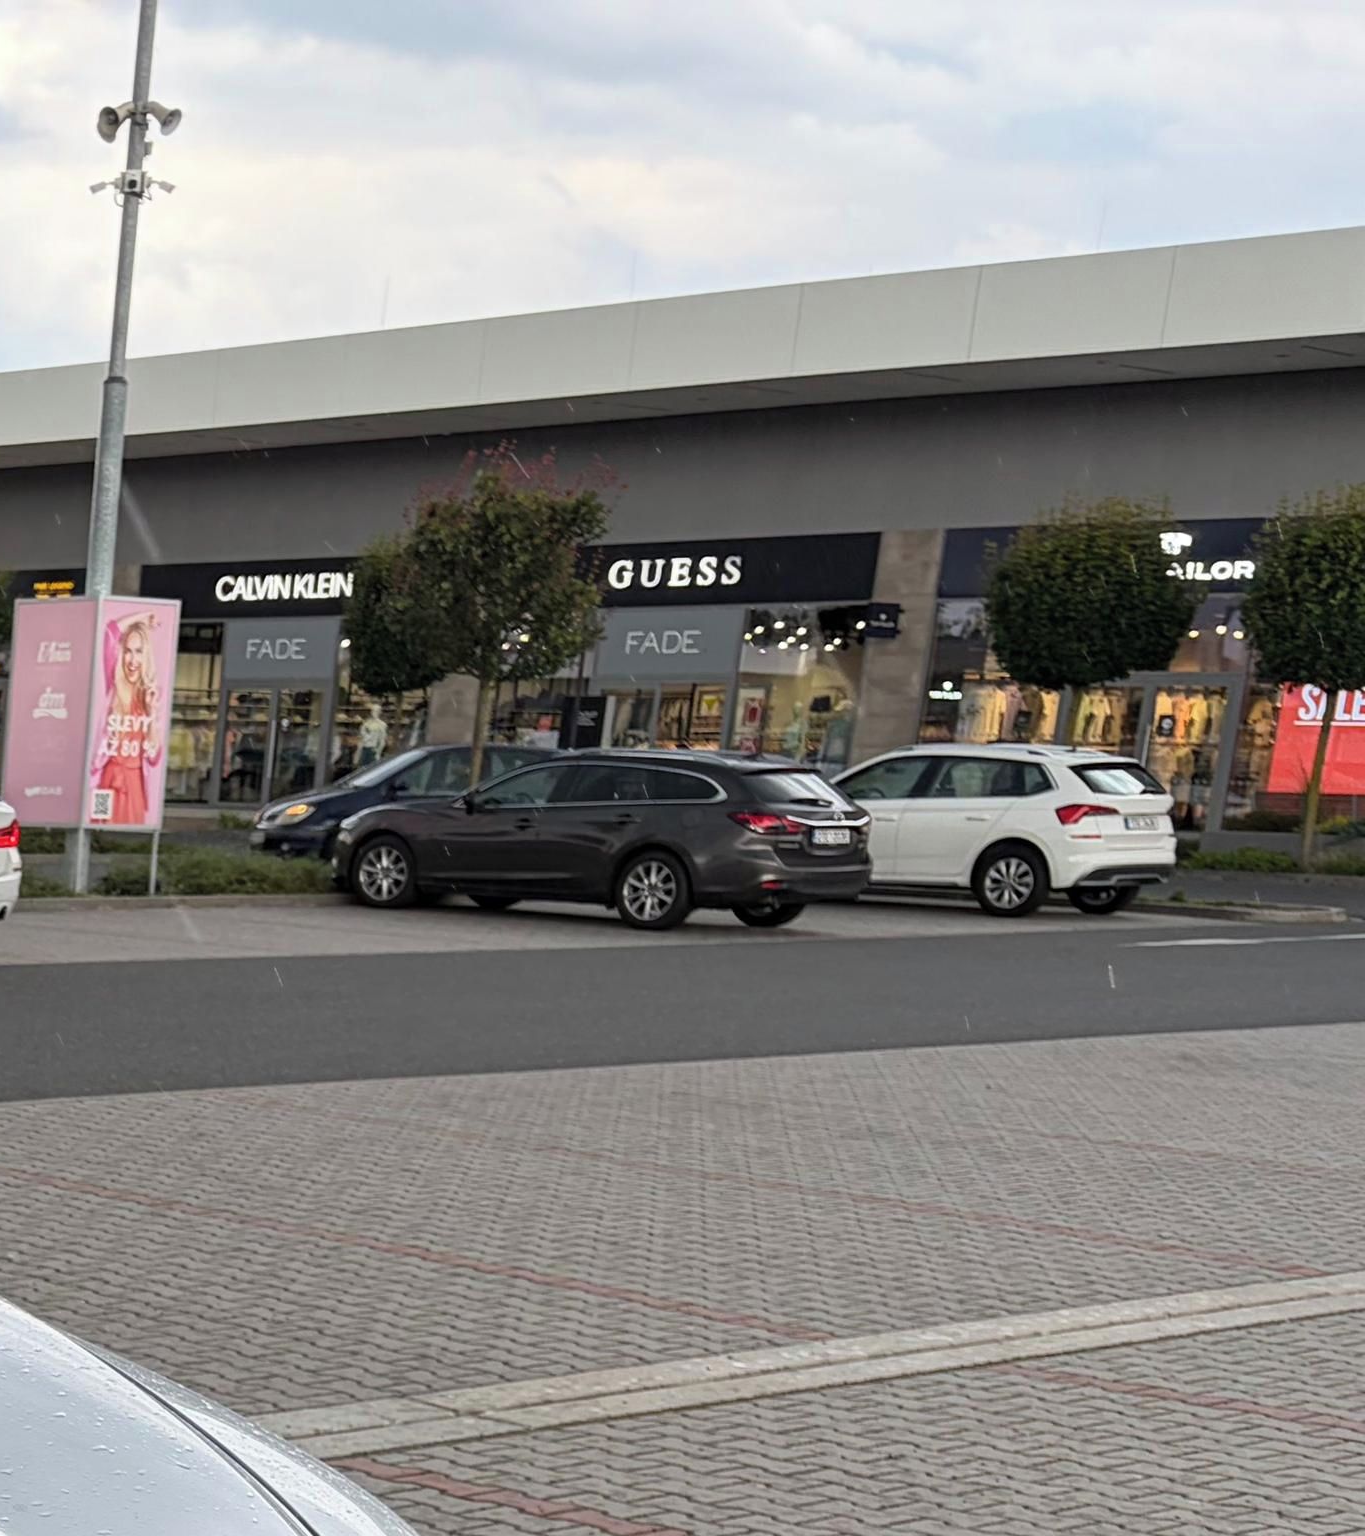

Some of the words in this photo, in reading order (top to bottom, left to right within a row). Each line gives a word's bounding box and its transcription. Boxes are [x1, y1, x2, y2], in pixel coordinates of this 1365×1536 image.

[607, 554, 743, 590] GUESS
[1166, 560, 1256, 581] AILOR
[215, 573, 291, 602] CALVIN
[292, 571, 353, 600] KLEIN
[245, 638, 307, 660] FADE
[624, 629, 702, 655] FADE
